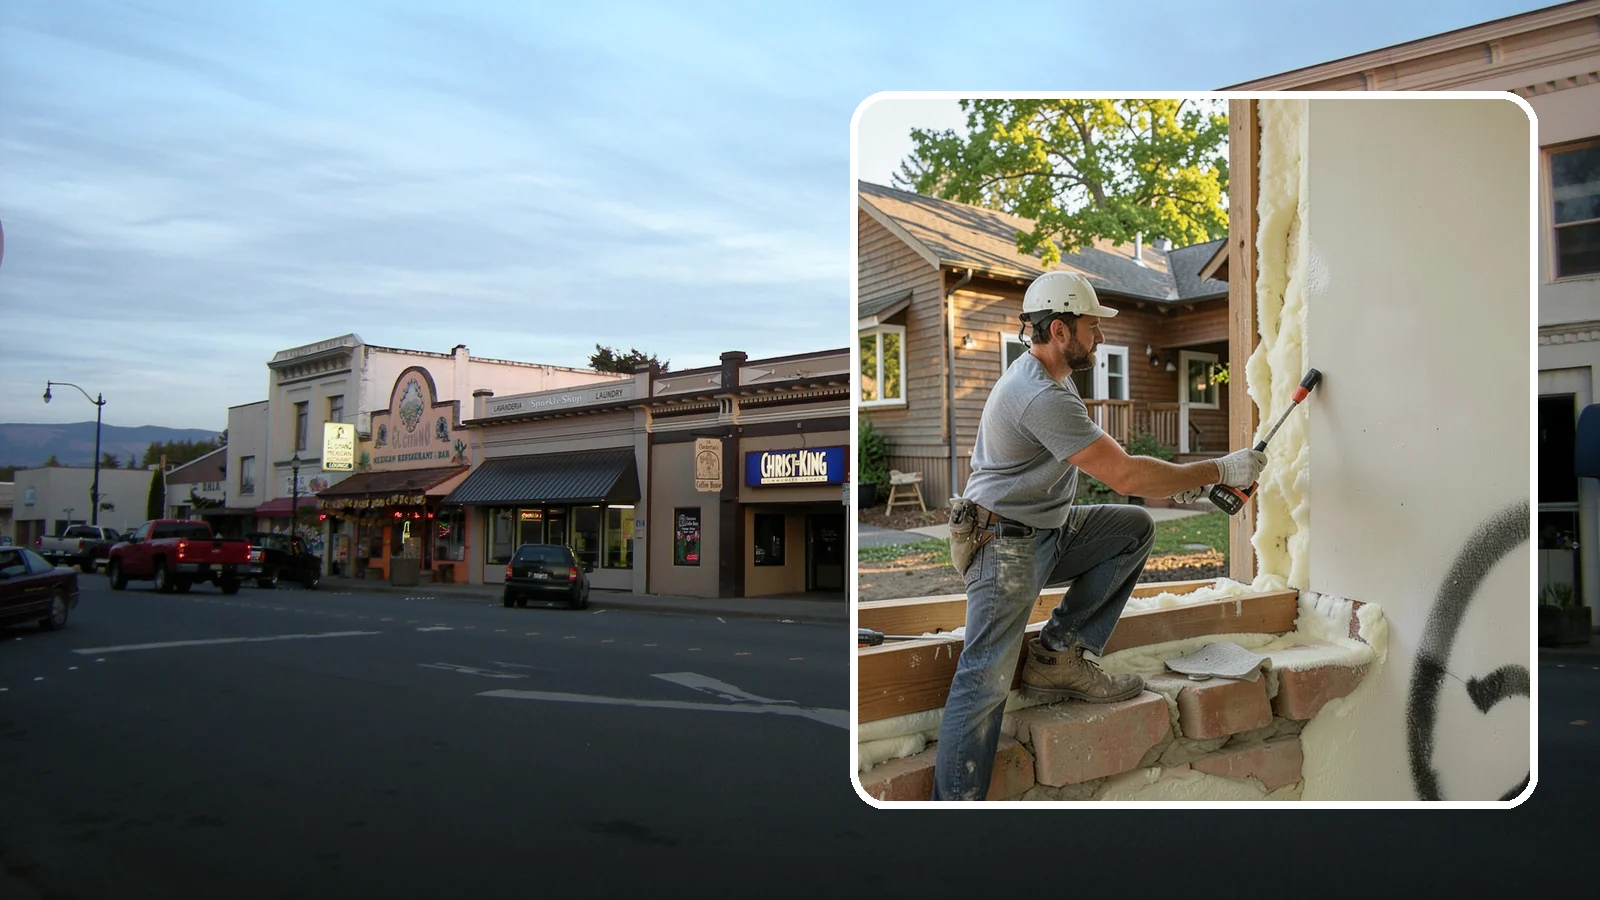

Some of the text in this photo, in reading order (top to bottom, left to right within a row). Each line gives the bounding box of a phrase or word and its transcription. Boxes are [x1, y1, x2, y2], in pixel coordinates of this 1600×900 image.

[531, 394, 582, 409] Sparkle Shop
[595, 389, 623, 400] LAUNDRY
[493, 402, 522, 413] LAVANDERIA
[373, 455, 396, 464] MEXICAN
[397, 451, 433, 462] RESTAURANT
[438, 450, 450, 459] BAR
[761, 450, 827, 478] CHRIST KING
